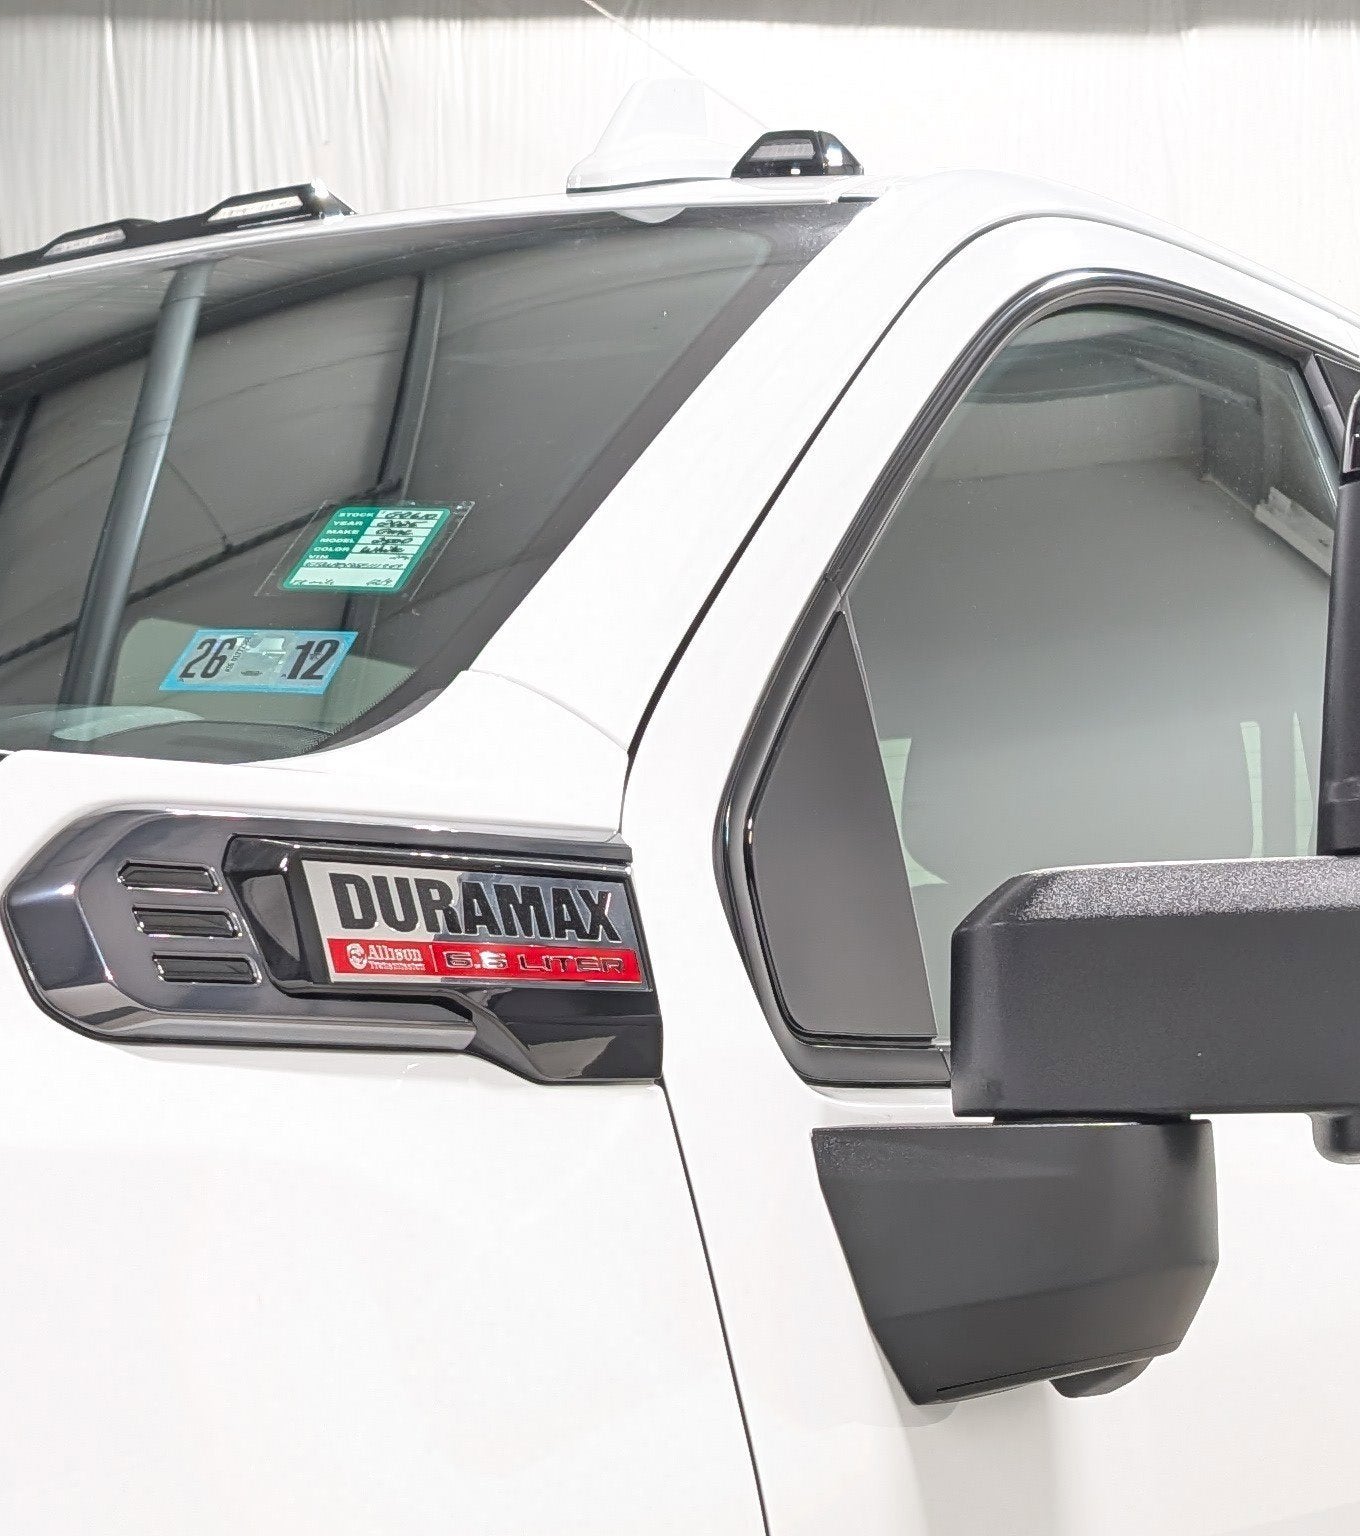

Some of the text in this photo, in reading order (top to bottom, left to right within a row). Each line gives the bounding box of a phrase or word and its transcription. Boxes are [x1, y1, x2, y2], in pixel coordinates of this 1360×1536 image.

[178, 637, 238, 679] 26
[286, 639, 340, 680] 12
[329, 872, 623, 943] DURAMAX
[368, 944, 626, 973] Allison 6.6 LITER
